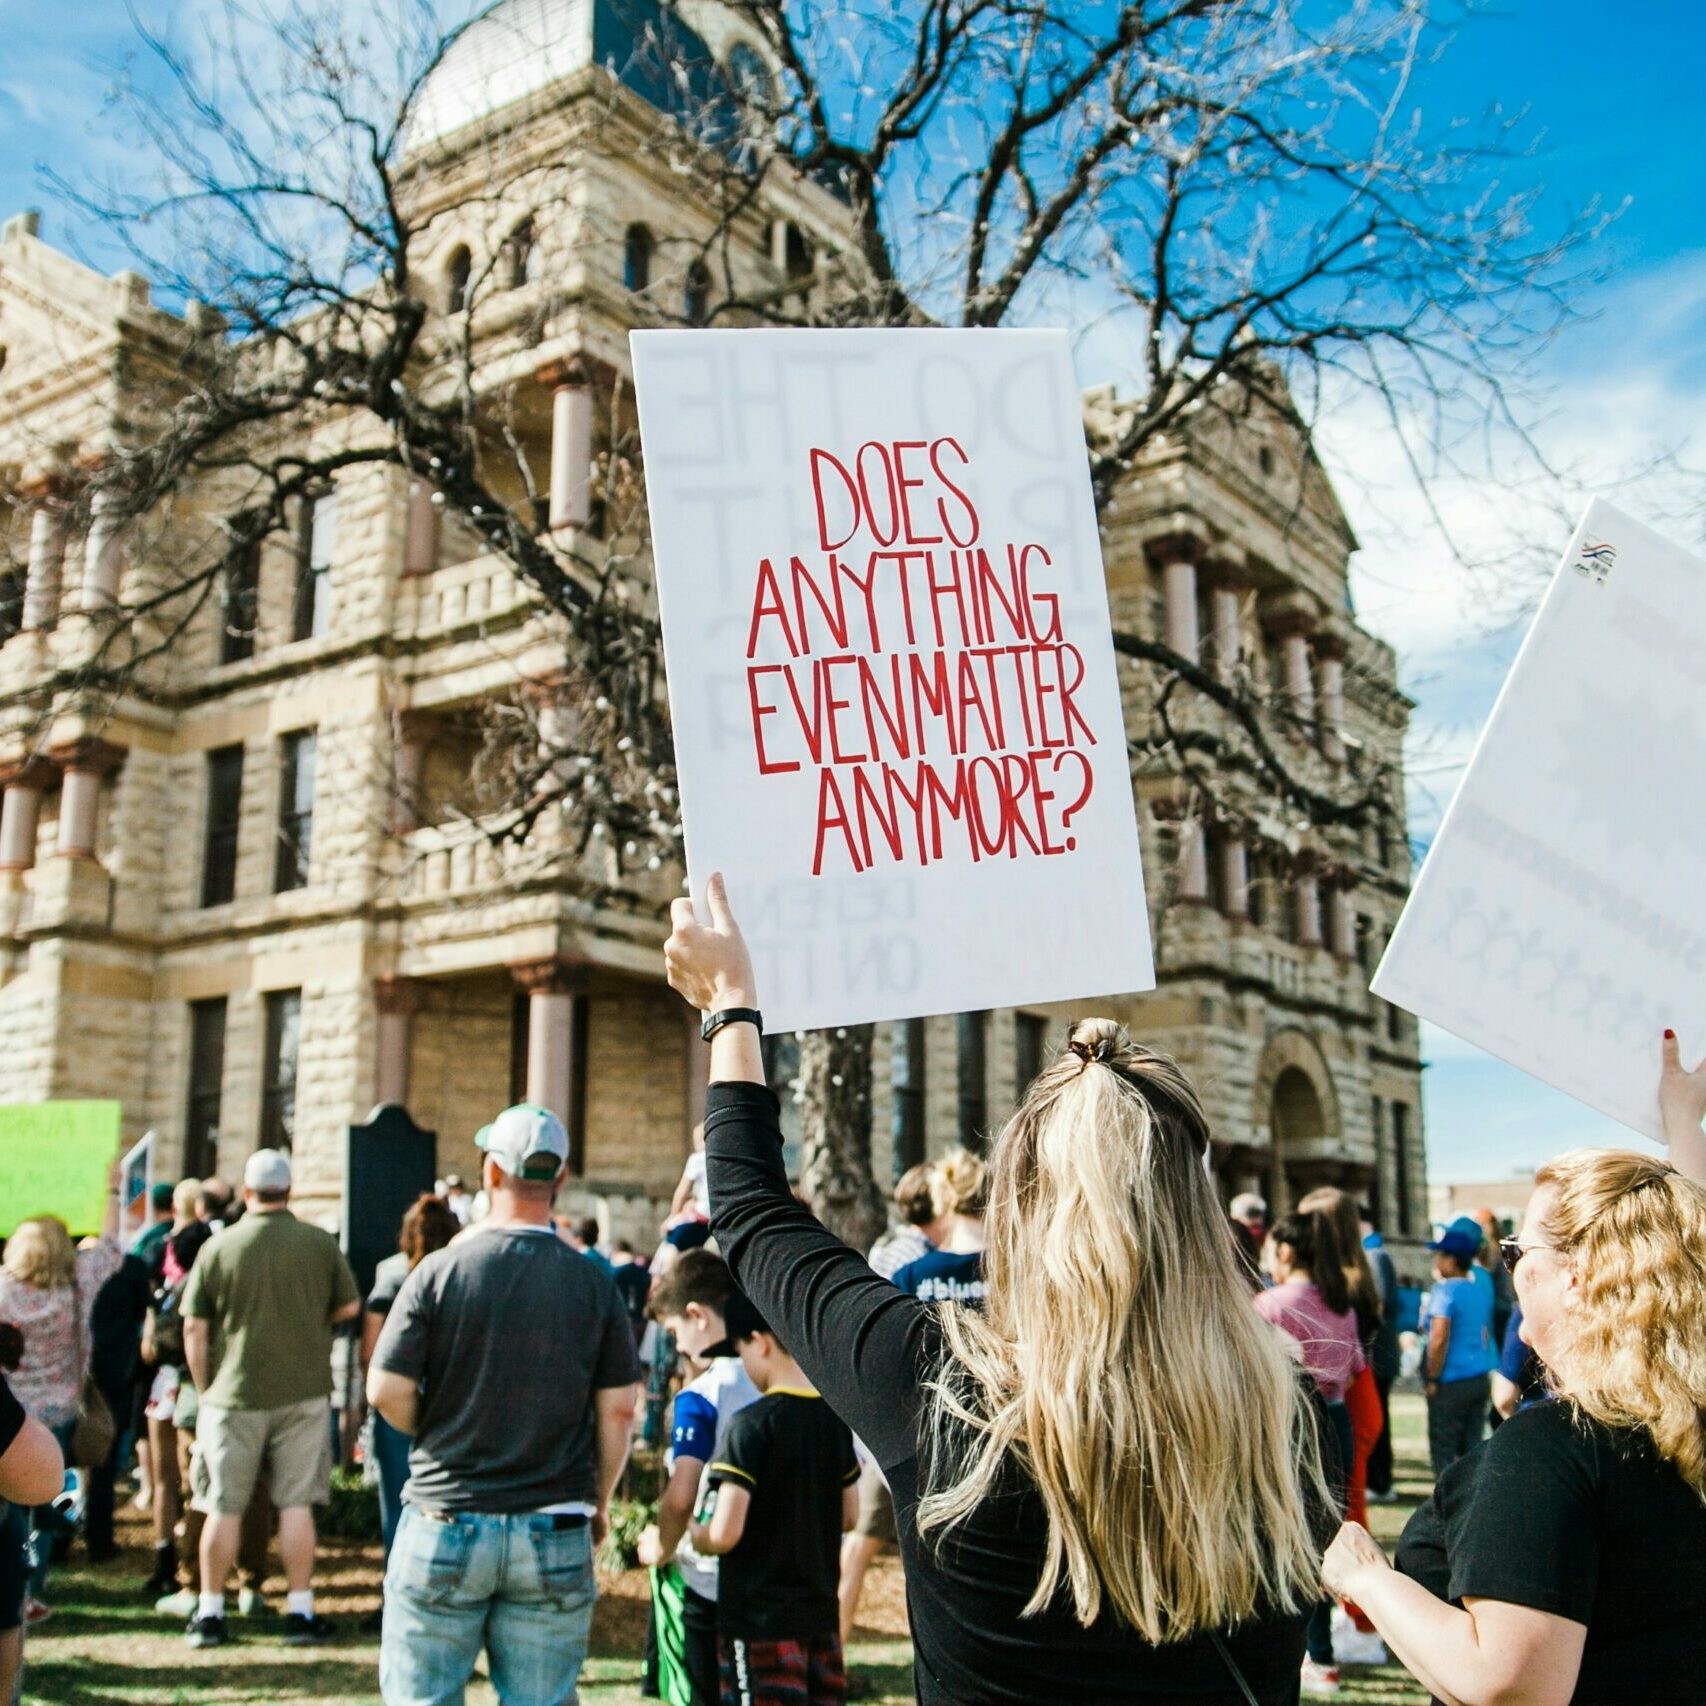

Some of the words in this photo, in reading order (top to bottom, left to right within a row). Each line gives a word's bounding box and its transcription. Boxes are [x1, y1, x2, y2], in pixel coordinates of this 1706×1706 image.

[810, 437, 980, 552] DOES
[746, 544, 1063, 659] ANYTHING
[747, 655, 909, 775] EVEN
[910, 642, 1097, 756] MATTER
[812, 750, 1093, 876] ANYMORE?
